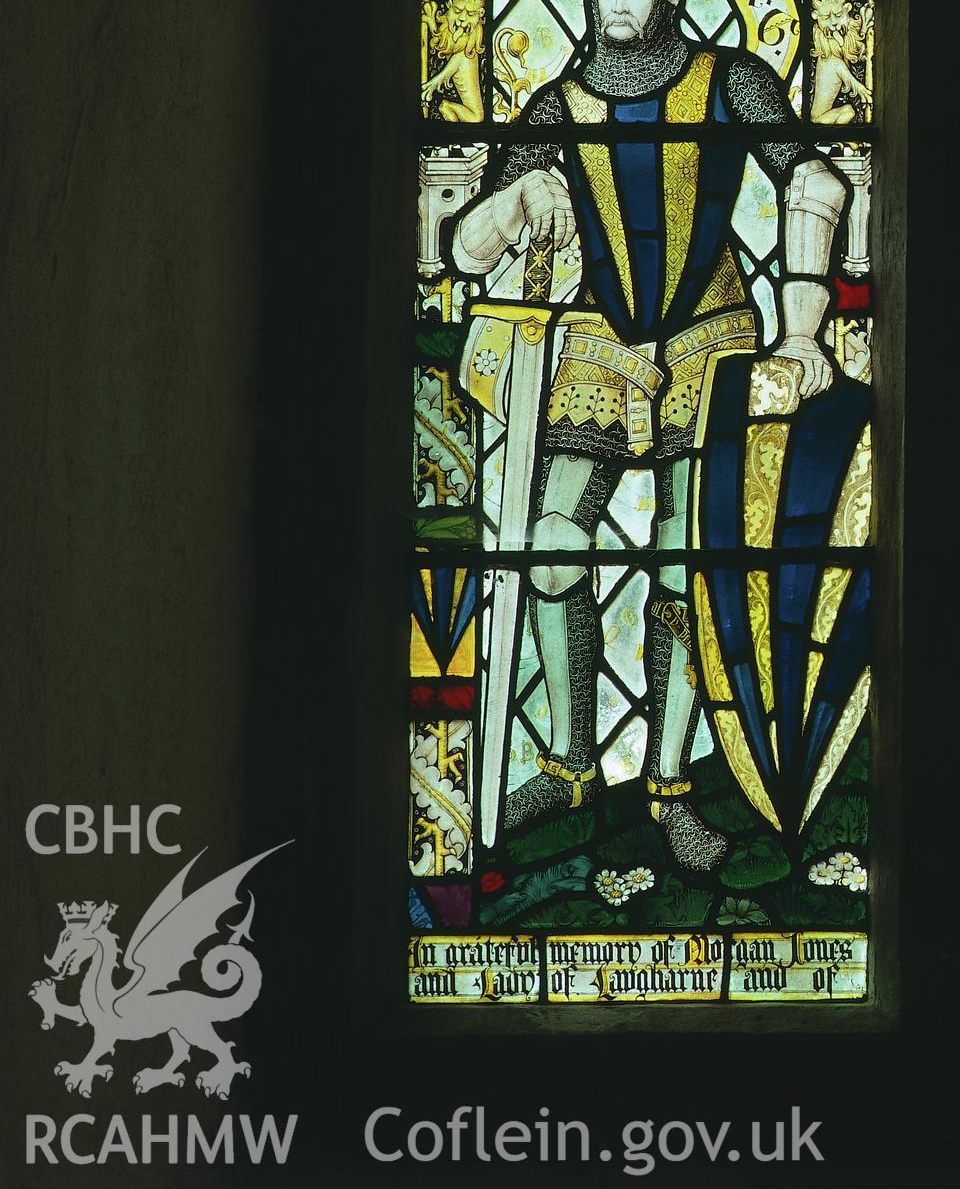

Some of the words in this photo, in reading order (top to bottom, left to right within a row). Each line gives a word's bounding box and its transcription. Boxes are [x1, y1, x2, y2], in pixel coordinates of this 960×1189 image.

[549, 940, 641, 968] memory
[651, 934, 675, 968] of
[782, 932, 856, 969] Jones
[414, 968, 458, 997] and
[551, 964, 578, 1000] of
[744, 963, 787, 992] and
[812, 963, 840, 999] of
